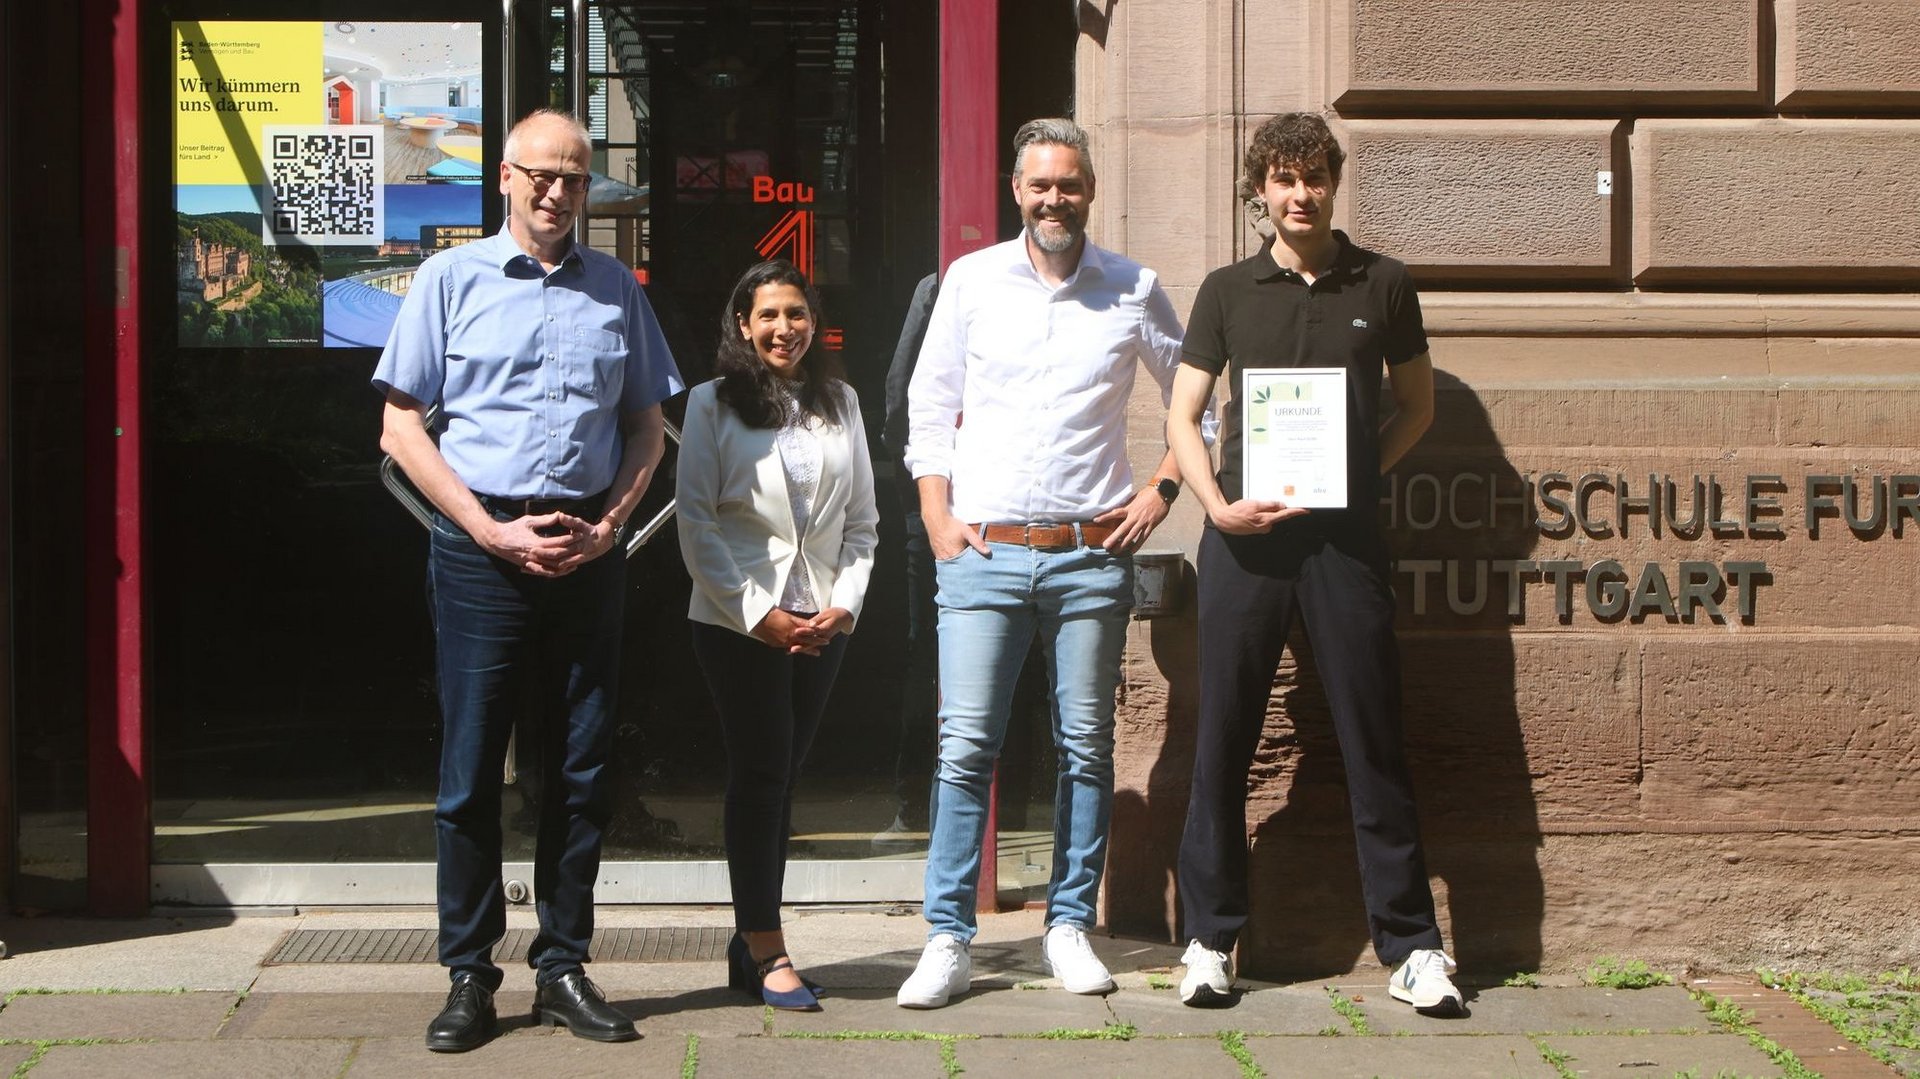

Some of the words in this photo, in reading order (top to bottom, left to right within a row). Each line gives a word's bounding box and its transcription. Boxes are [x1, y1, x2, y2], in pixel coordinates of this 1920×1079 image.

[179, 78, 212, 93] Wir
[216, 78, 300, 93] kümmern
[179, 101, 211, 112] uns
[216, 98, 278, 112] darum.
[179, 144, 199, 152] Unser
[200, 144, 225, 153] Beitrag
[753, 176, 814, 203] Bau
[1275, 406, 1324, 417] URKUNDE
[1390, 559, 1767, 619] TUTTGART
